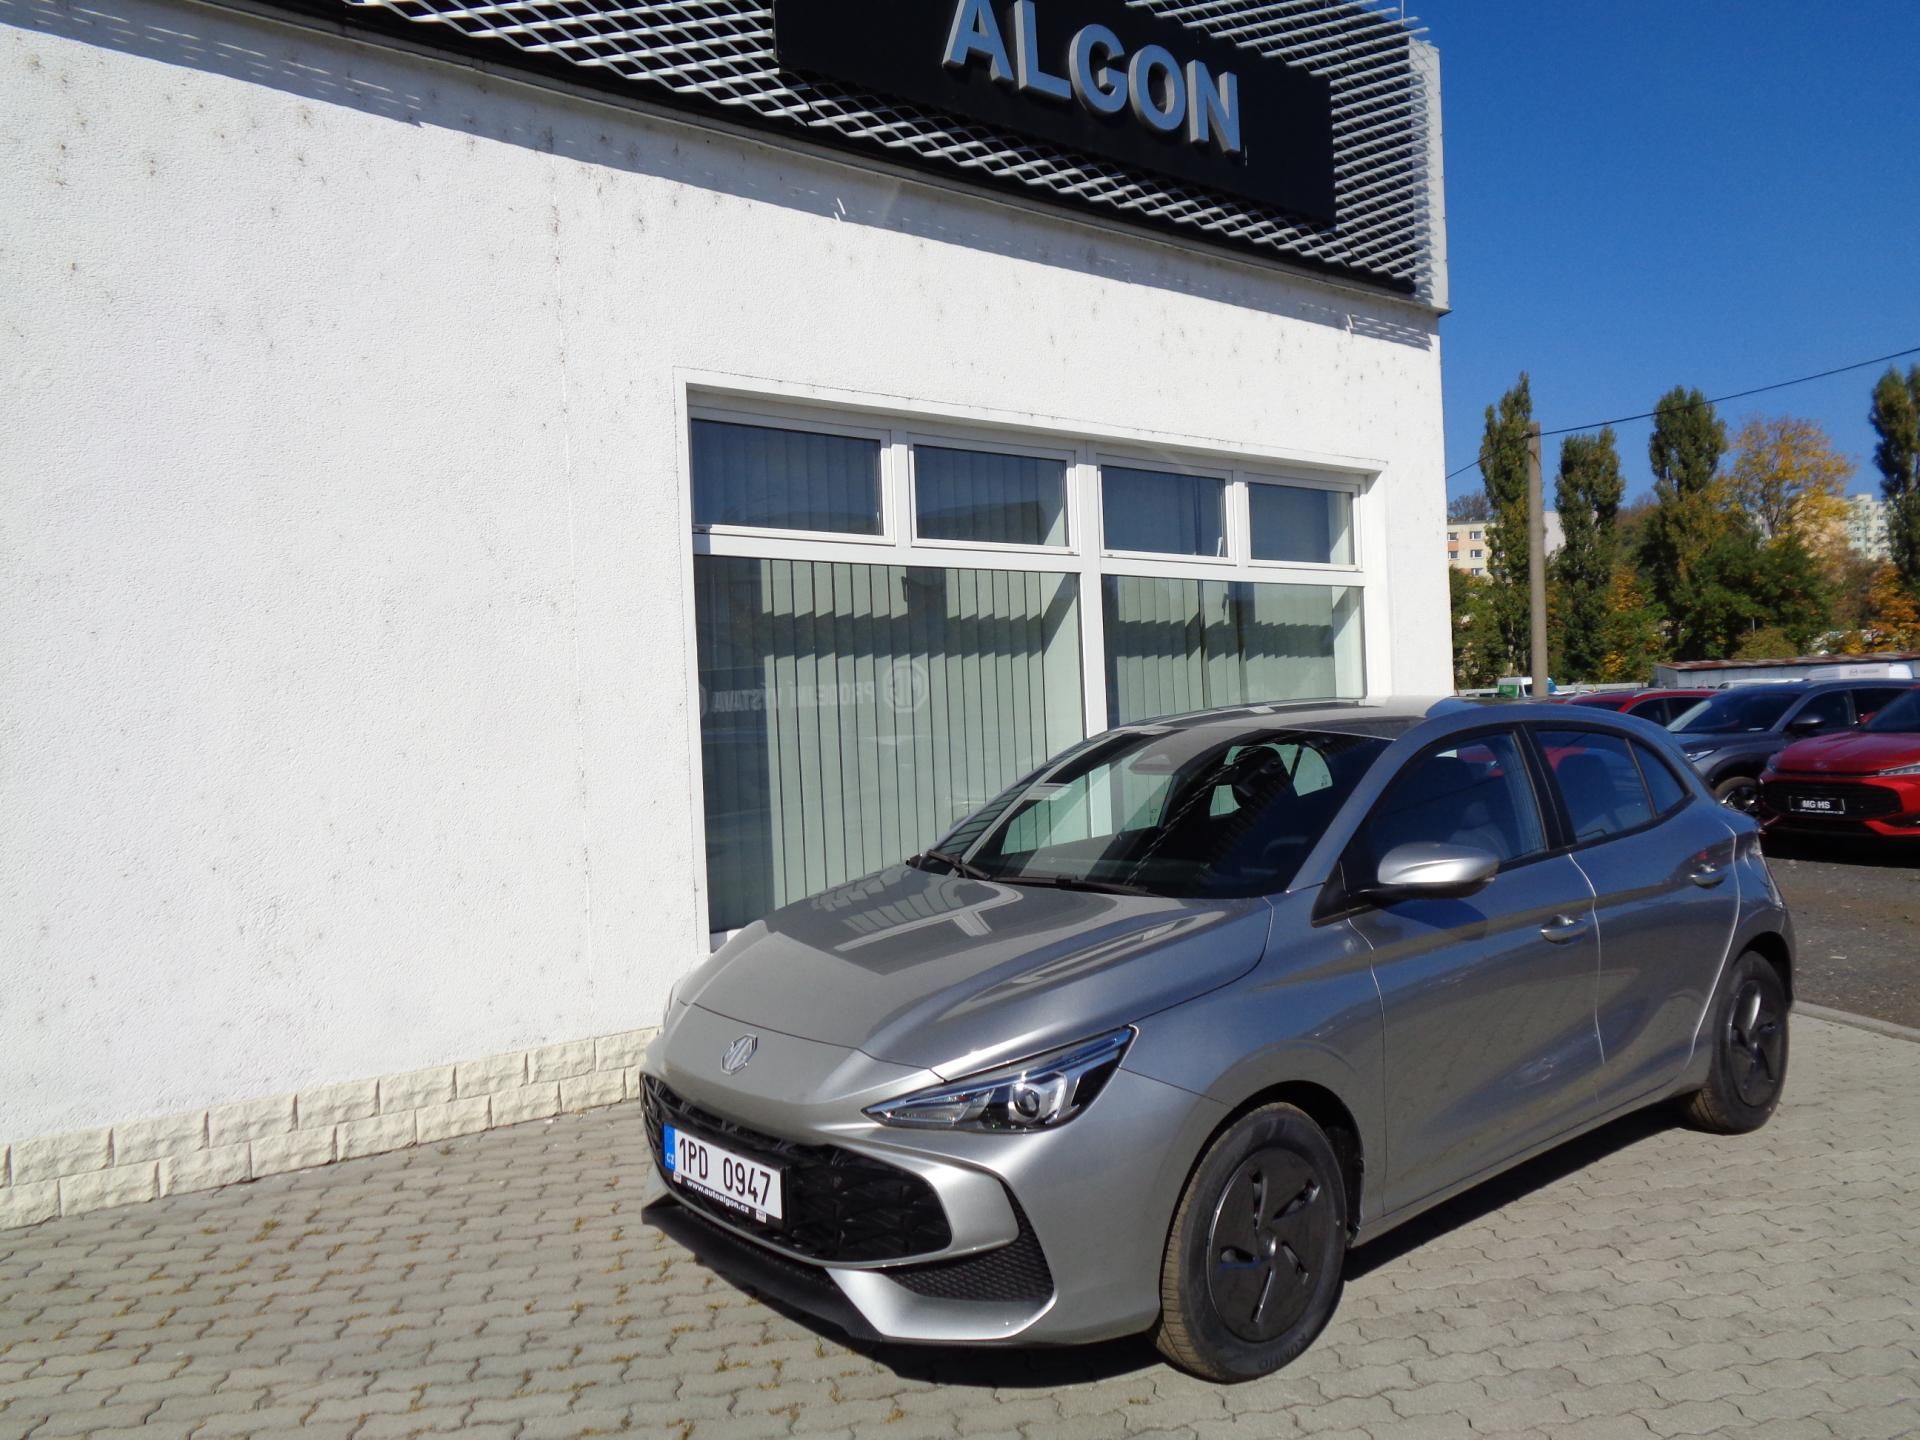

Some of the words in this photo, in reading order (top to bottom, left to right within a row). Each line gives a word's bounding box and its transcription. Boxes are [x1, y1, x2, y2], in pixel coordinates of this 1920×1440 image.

[942, 0, 1241, 153] ALGON
[1802, 799, 1816, 808] MG
[1817, 800, 1831, 809] HS
[666, 1153, 675, 1165] CZ
[679, 1137, 708, 1180] 1PD
[723, 1157, 771, 1206] 0947
[686, 1179, 750, 1214] www.autoalgon.cz
